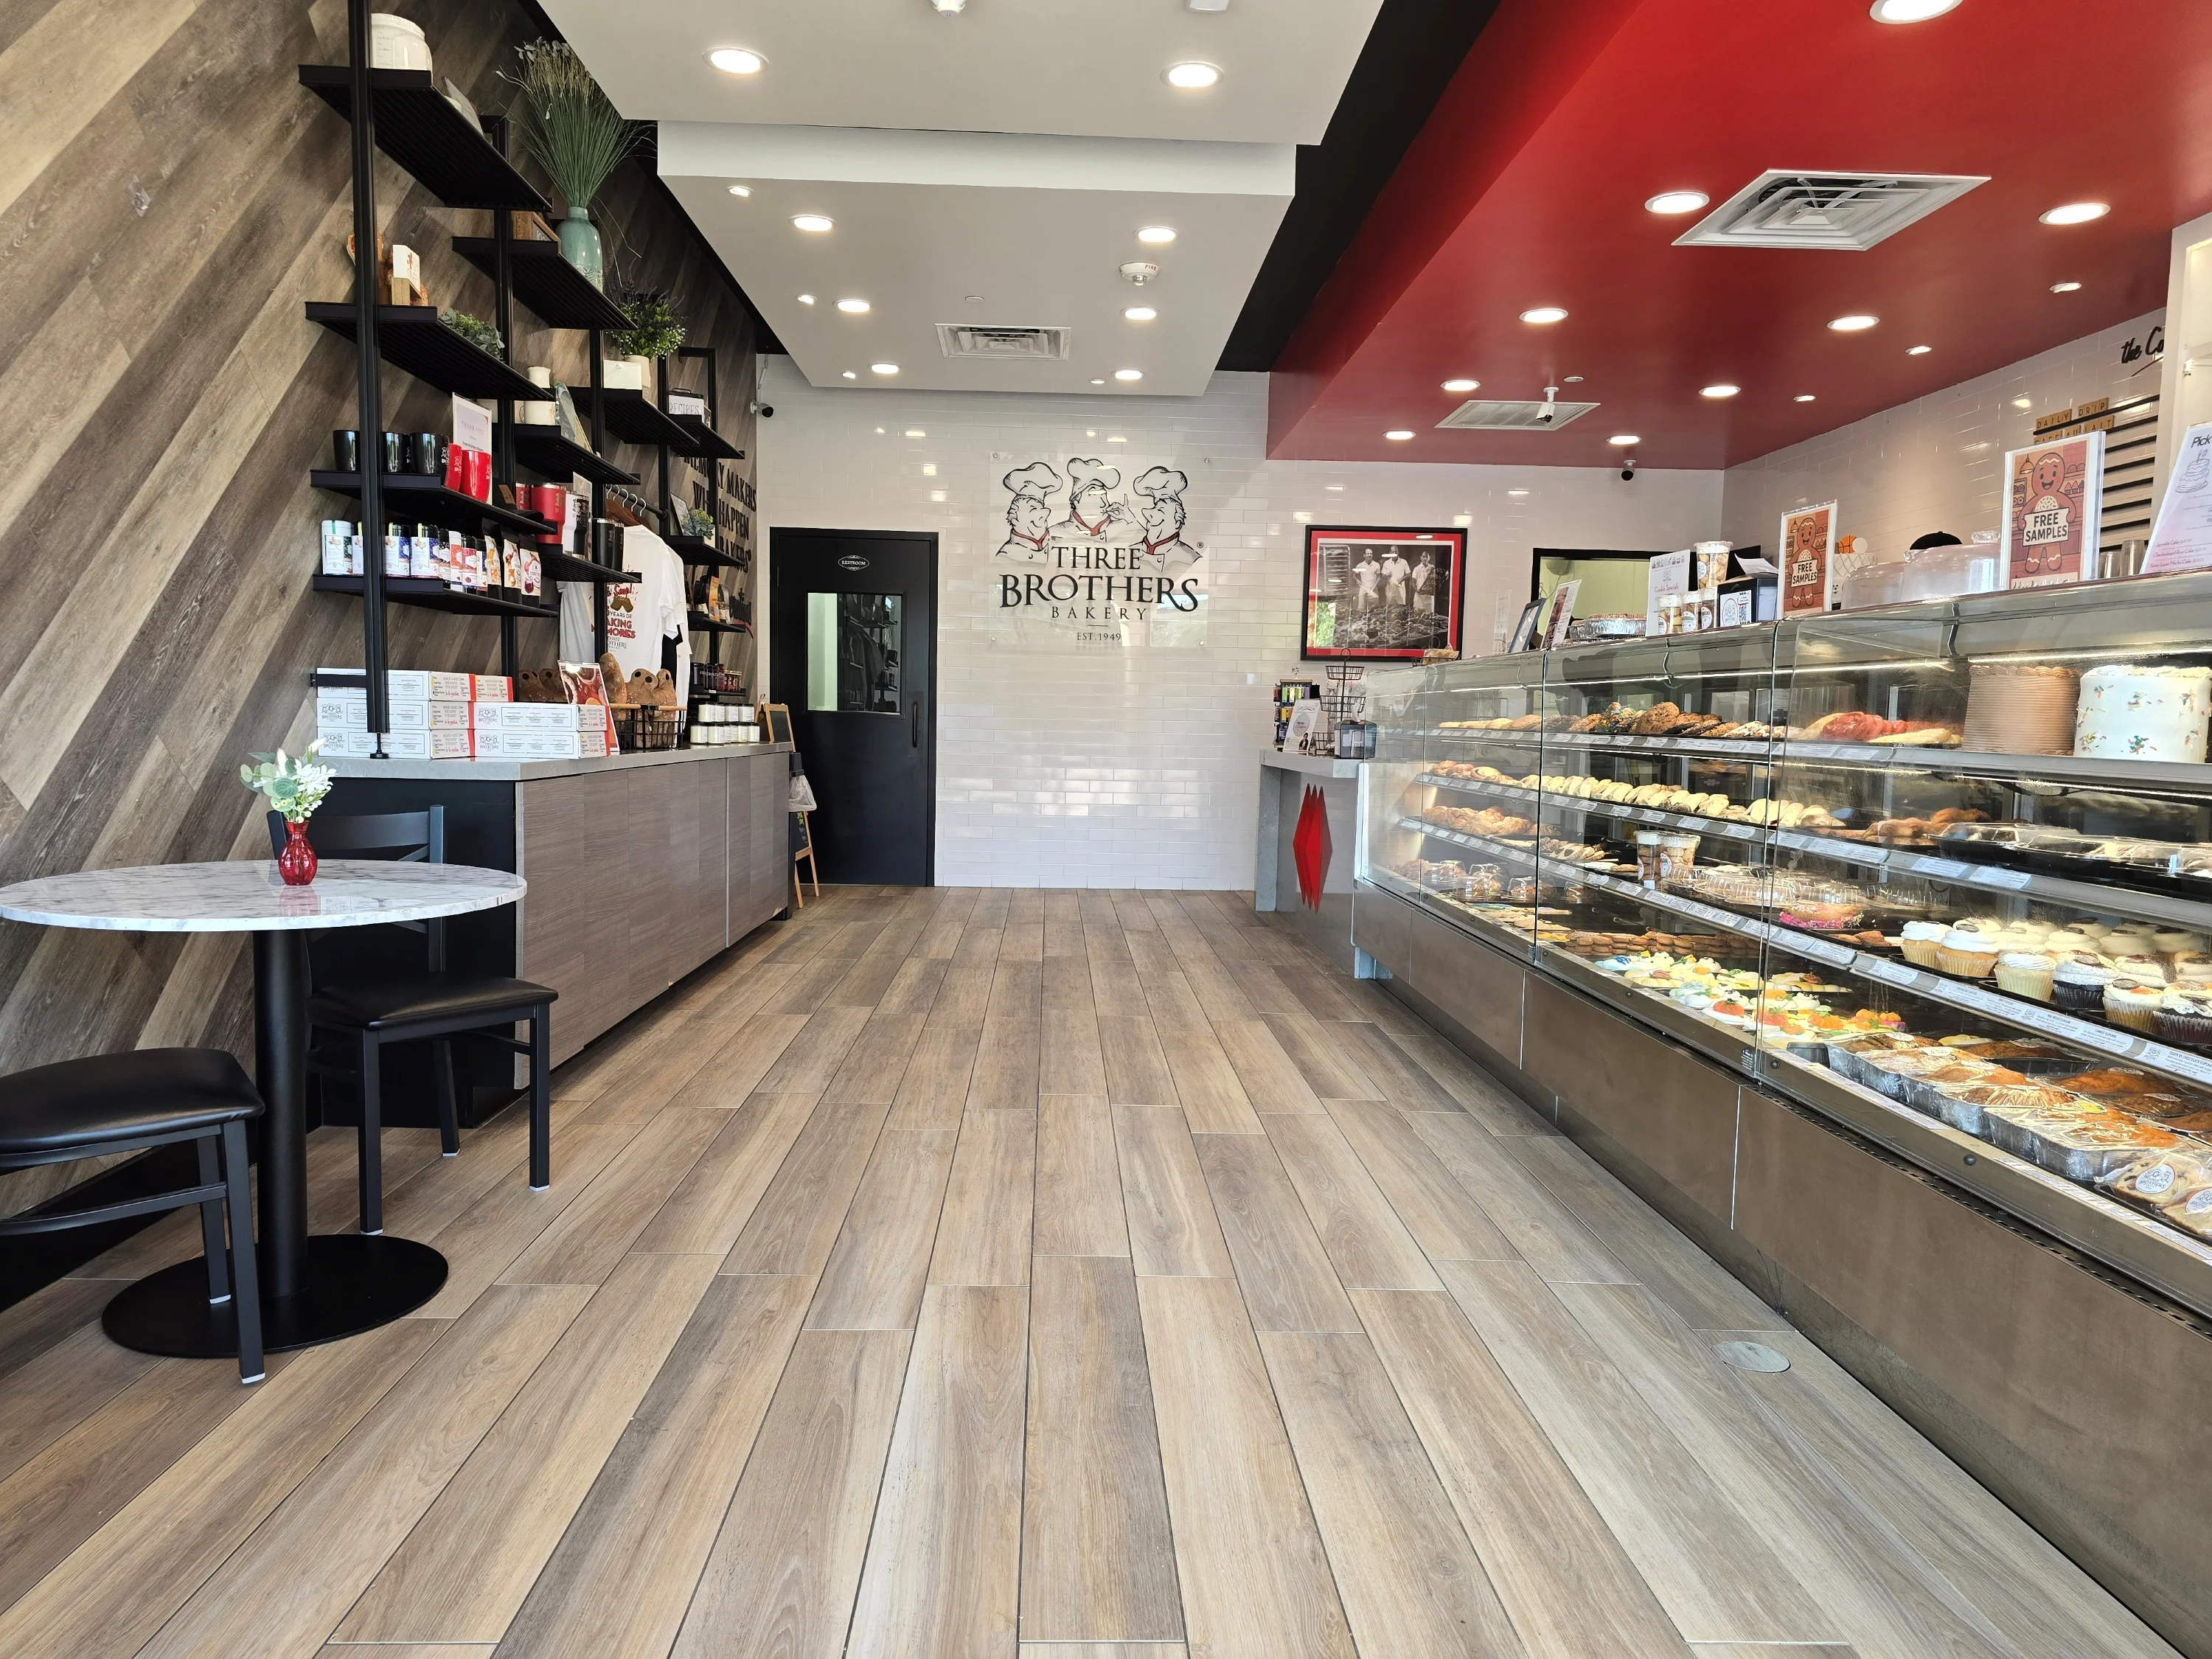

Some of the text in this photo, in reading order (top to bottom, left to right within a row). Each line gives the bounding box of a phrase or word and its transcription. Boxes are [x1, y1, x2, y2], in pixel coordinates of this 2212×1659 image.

[2121, 337, 2142, 364] the
[669, 403, 700, 414] RECIPES
[2037, 402, 2105, 428] DAILY DRIP
[462, 421, 475, 430] THANK
[2191, 434, 2212, 448] Pick
[726, 468, 757, 512] MAKERS
[718, 498, 749, 540] HAPPEN
[2034, 512, 2059, 528] FREE
[2025, 525, 2067, 542] SAMPLES
[1051, 546, 1142, 570] THREE
[1798, 562, 1812, 574] FREE
[1792, 571, 1817, 584] SAMPLES
[998, 573, 1199, 612] BROTHERS
[1666, 582, 1679, 591] Specials
[1051, 606, 1147, 620] BAKERY
[607, 617, 632, 629] AKING
[1077, 632, 1121, 641] EST.1949
[608, 640, 627, 649] OTHERS
[2183, 1055, 2200, 1064] CHOCOLATE
[2139, 1180, 2166, 1189] BROTHERS
